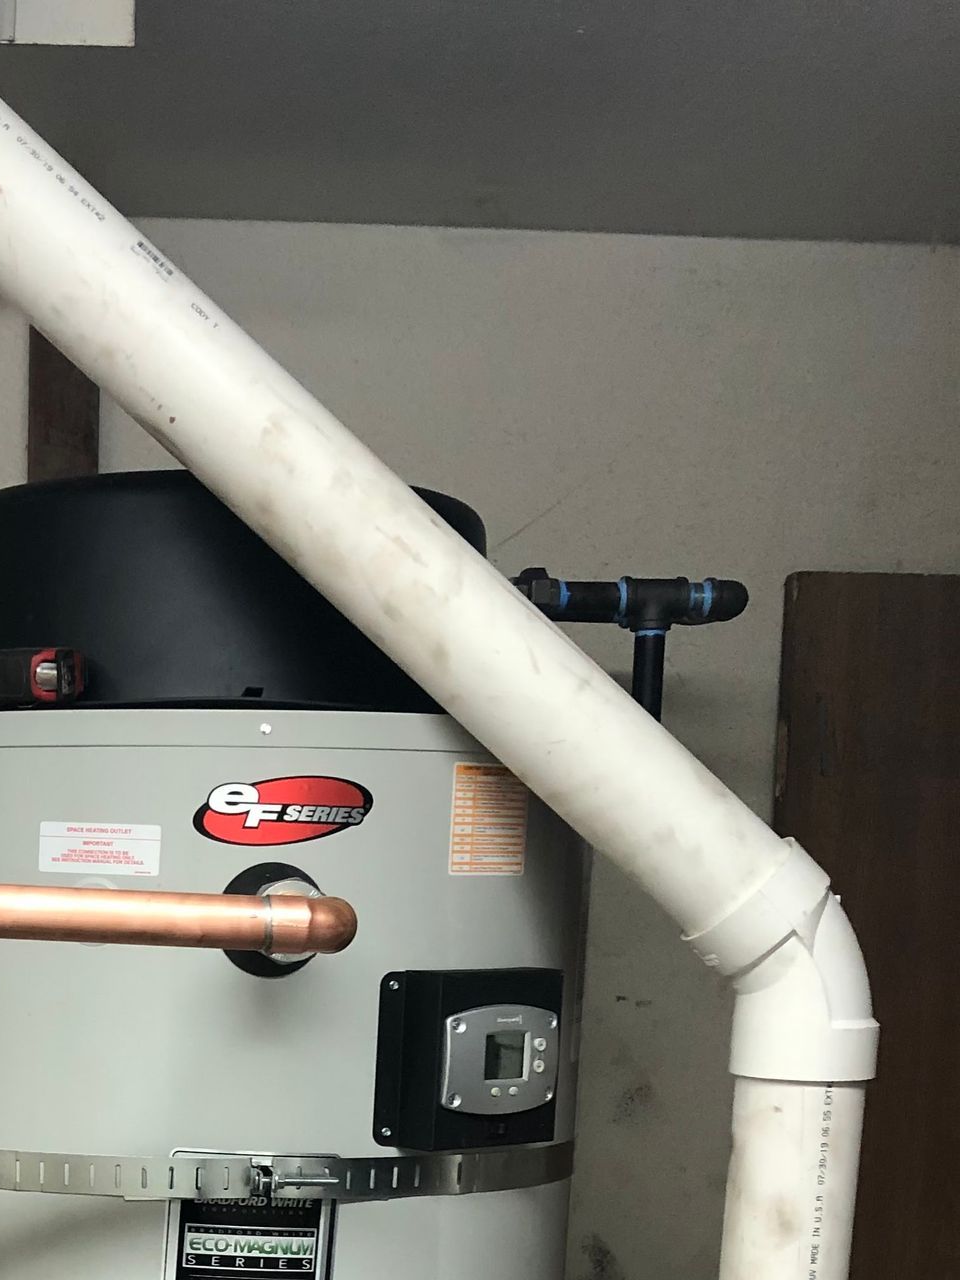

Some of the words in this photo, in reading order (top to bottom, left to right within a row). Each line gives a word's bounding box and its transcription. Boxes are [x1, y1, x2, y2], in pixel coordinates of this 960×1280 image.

[283, 805, 364, 824] SERIES
[812, 1227, 820, 1237] IN
[187, 1255, 311, 1269] SERIES
[810, 1244, 819, 1264] MADE
